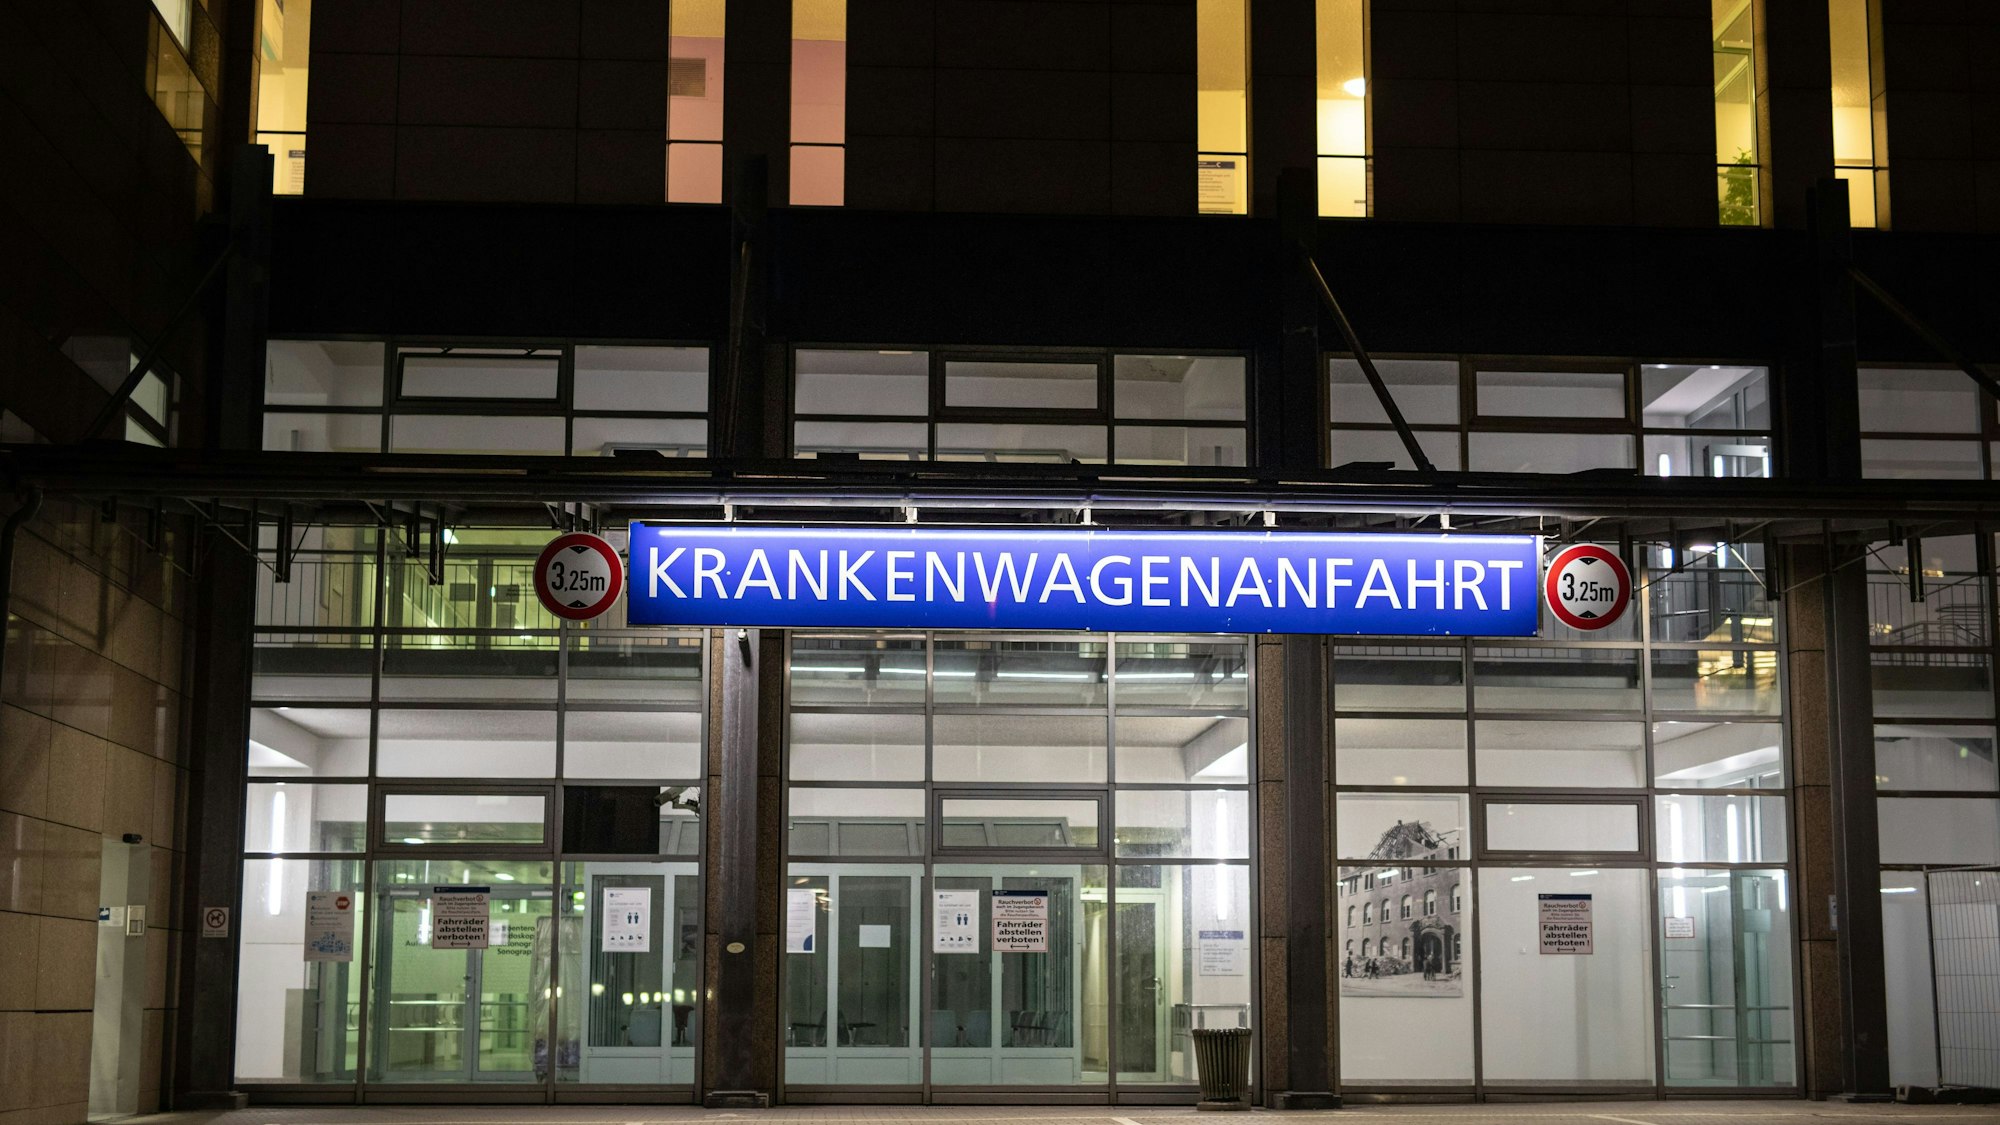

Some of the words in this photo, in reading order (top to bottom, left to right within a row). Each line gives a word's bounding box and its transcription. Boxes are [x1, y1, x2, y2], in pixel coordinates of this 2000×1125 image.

[552, 562, 604, 592] 3,25m
[649, 547, 1523, 611] KRANKENWAGENANFAHRT
[1562, 573, 1614, 602] 3,25m
